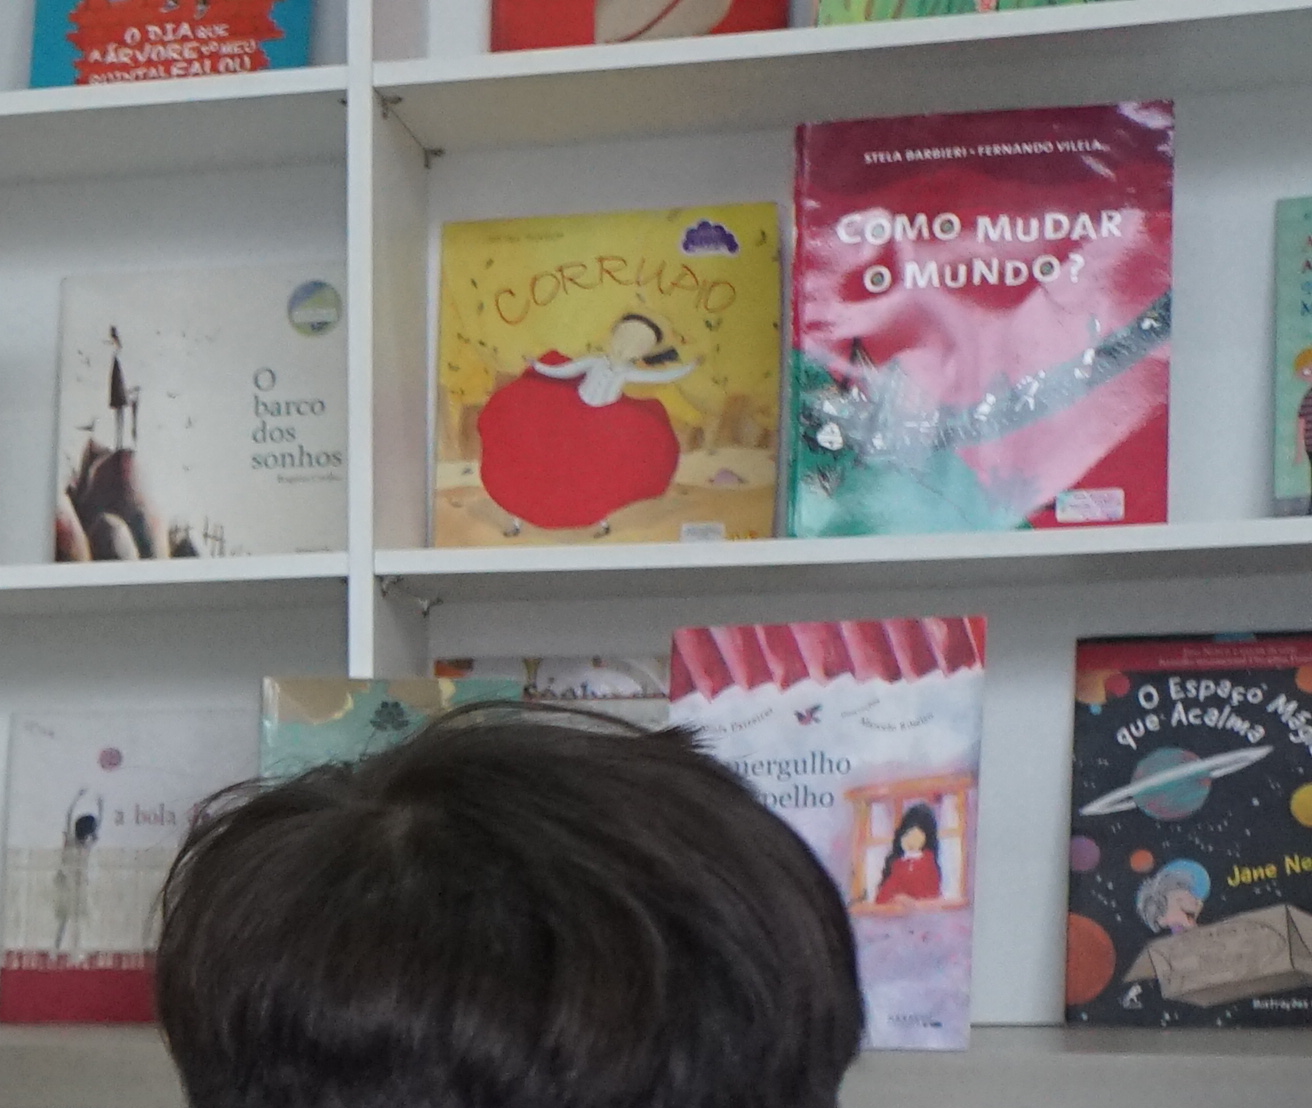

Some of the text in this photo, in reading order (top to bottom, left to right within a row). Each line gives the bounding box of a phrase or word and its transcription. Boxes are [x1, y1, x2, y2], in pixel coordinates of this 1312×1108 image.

[124, 26, 141, 46] O
[145, 21, 193, 42] DIA
[863, 138, 1103, 165] STELA BARBIERI FERNANDO VILELA
[835, 208, 1123, 247] COMO MUDAR
[863, 252, 1085, 294] O MUNDO?
[253, 367, 276, 391] O
[253, 395, 326, 418] barco
[251, 420, 296, 443] dos
[251, 445, 343, 470] sonhos
[1137, 684, 1160, 710] O
[1169, 676, 1264, 707] Espaço
[1115, 700, 1266, 751] que Acalma
[134, 802, 177, 827] bola
[1226, 863, 1278, 887] Jane
